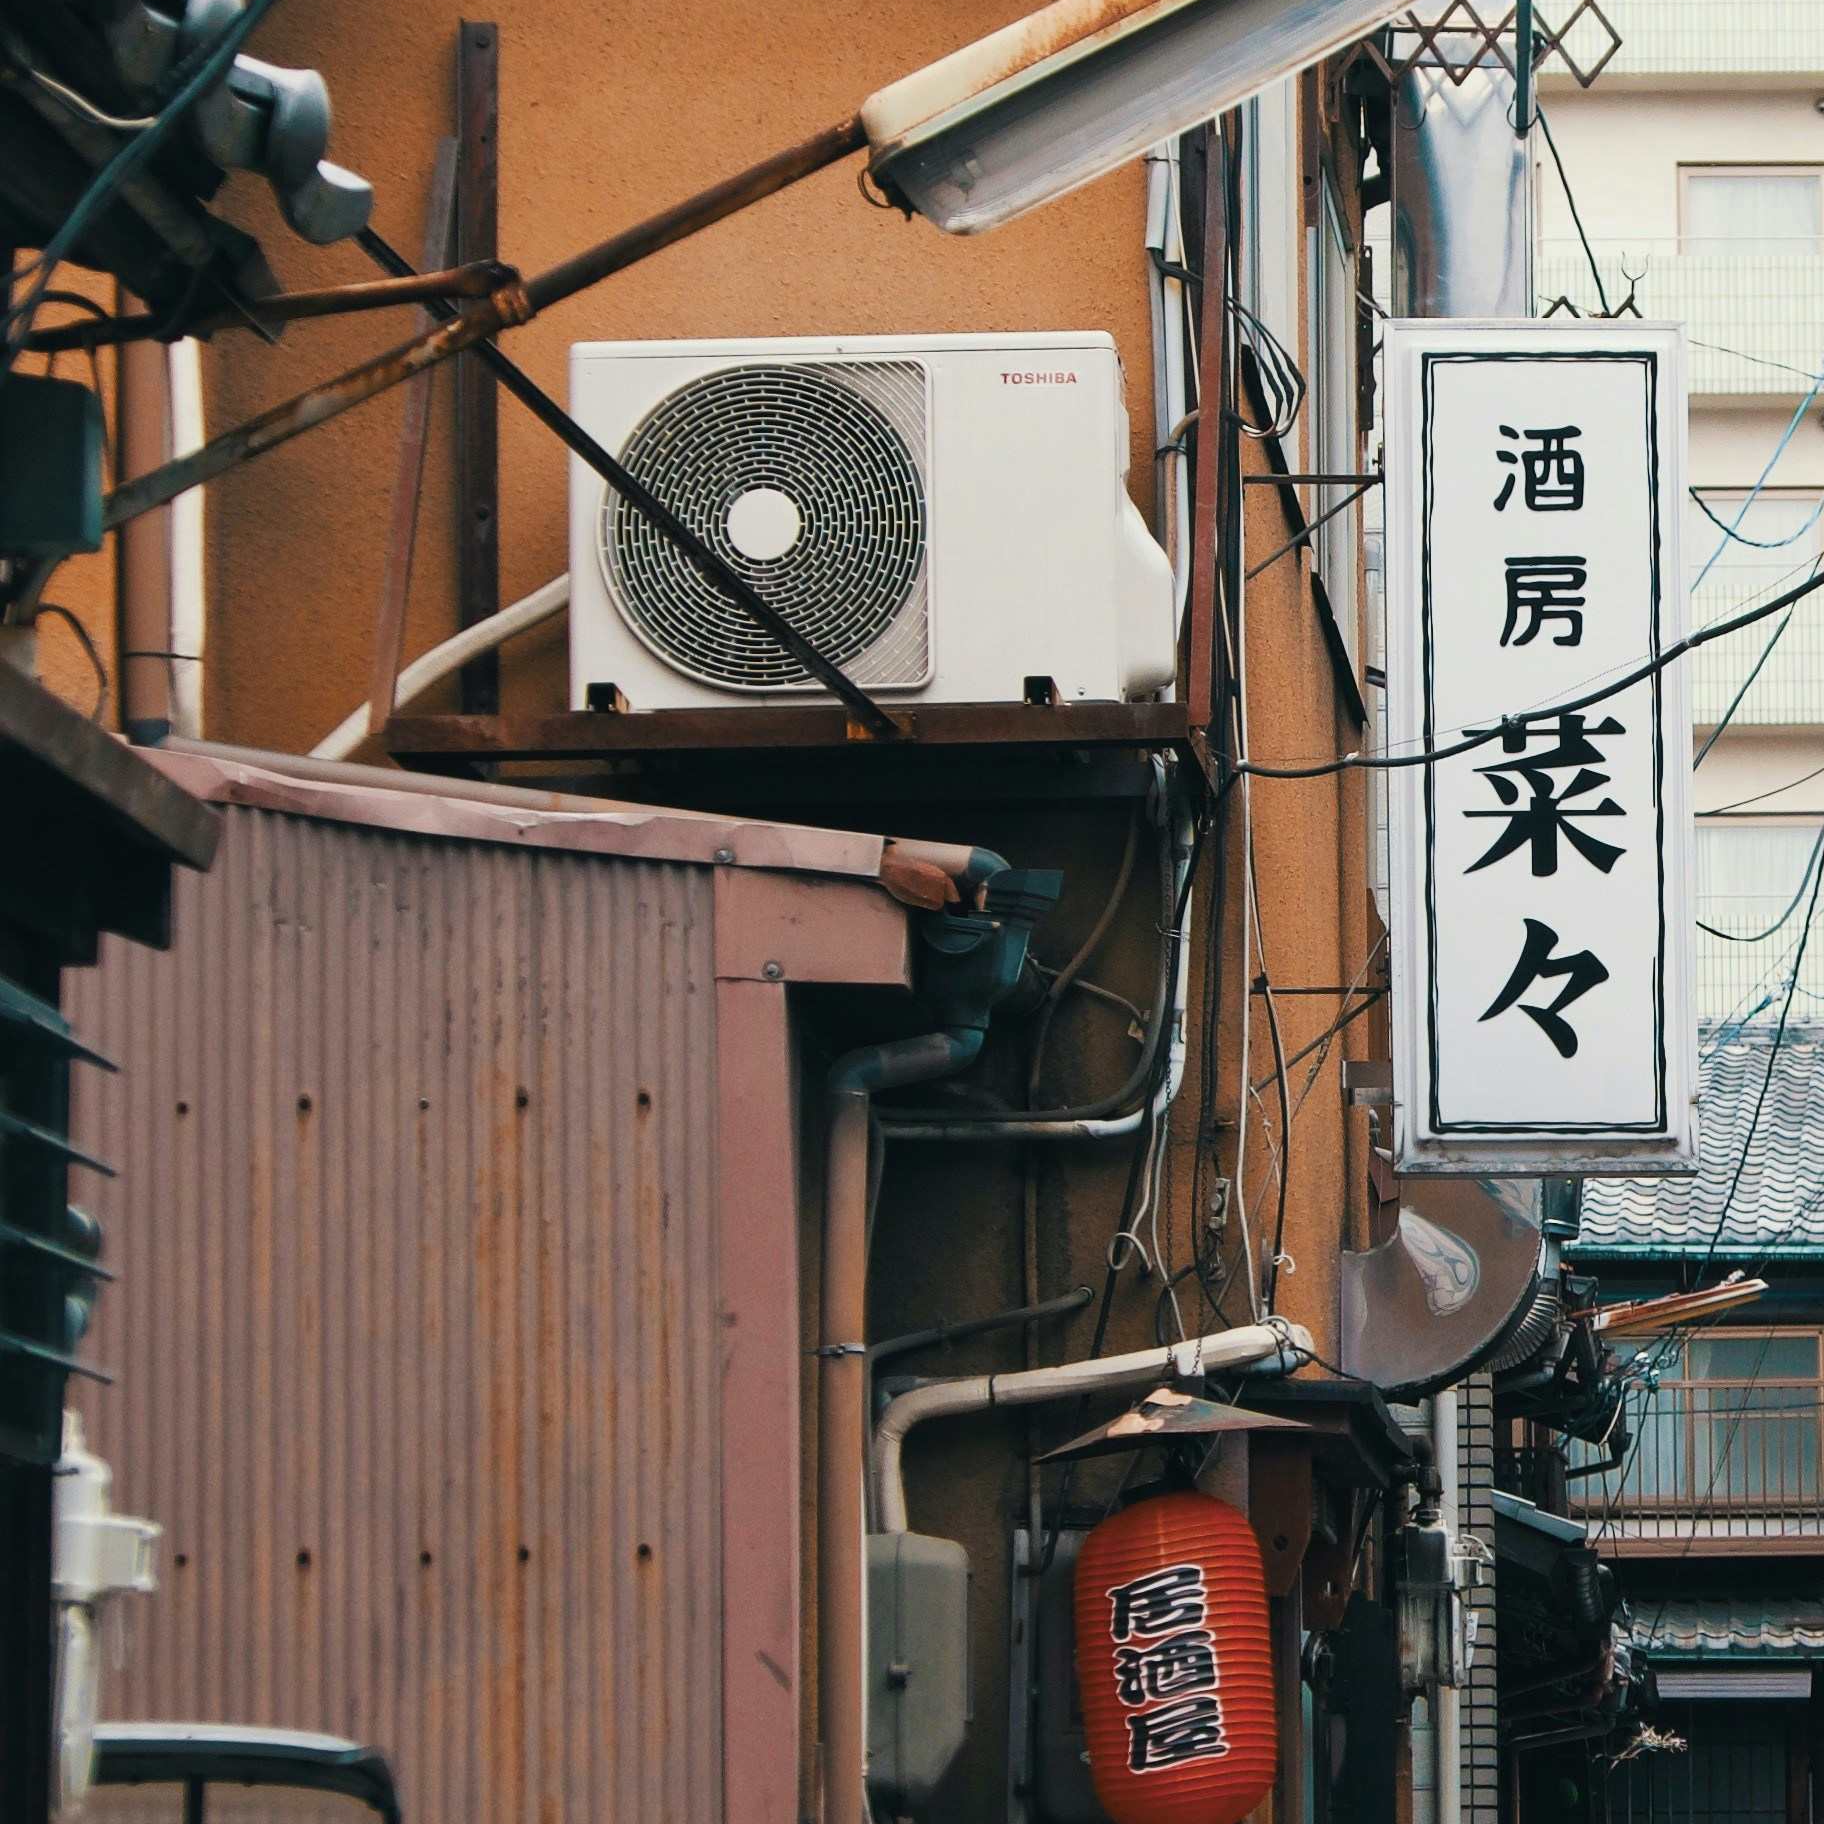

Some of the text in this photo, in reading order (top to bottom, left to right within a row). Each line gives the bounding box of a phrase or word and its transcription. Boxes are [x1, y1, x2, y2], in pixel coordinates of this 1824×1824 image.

[1000, 373, 1077, 385] TOSHIBA
[1106, 1564, 1230, 1774] 居酒屋
